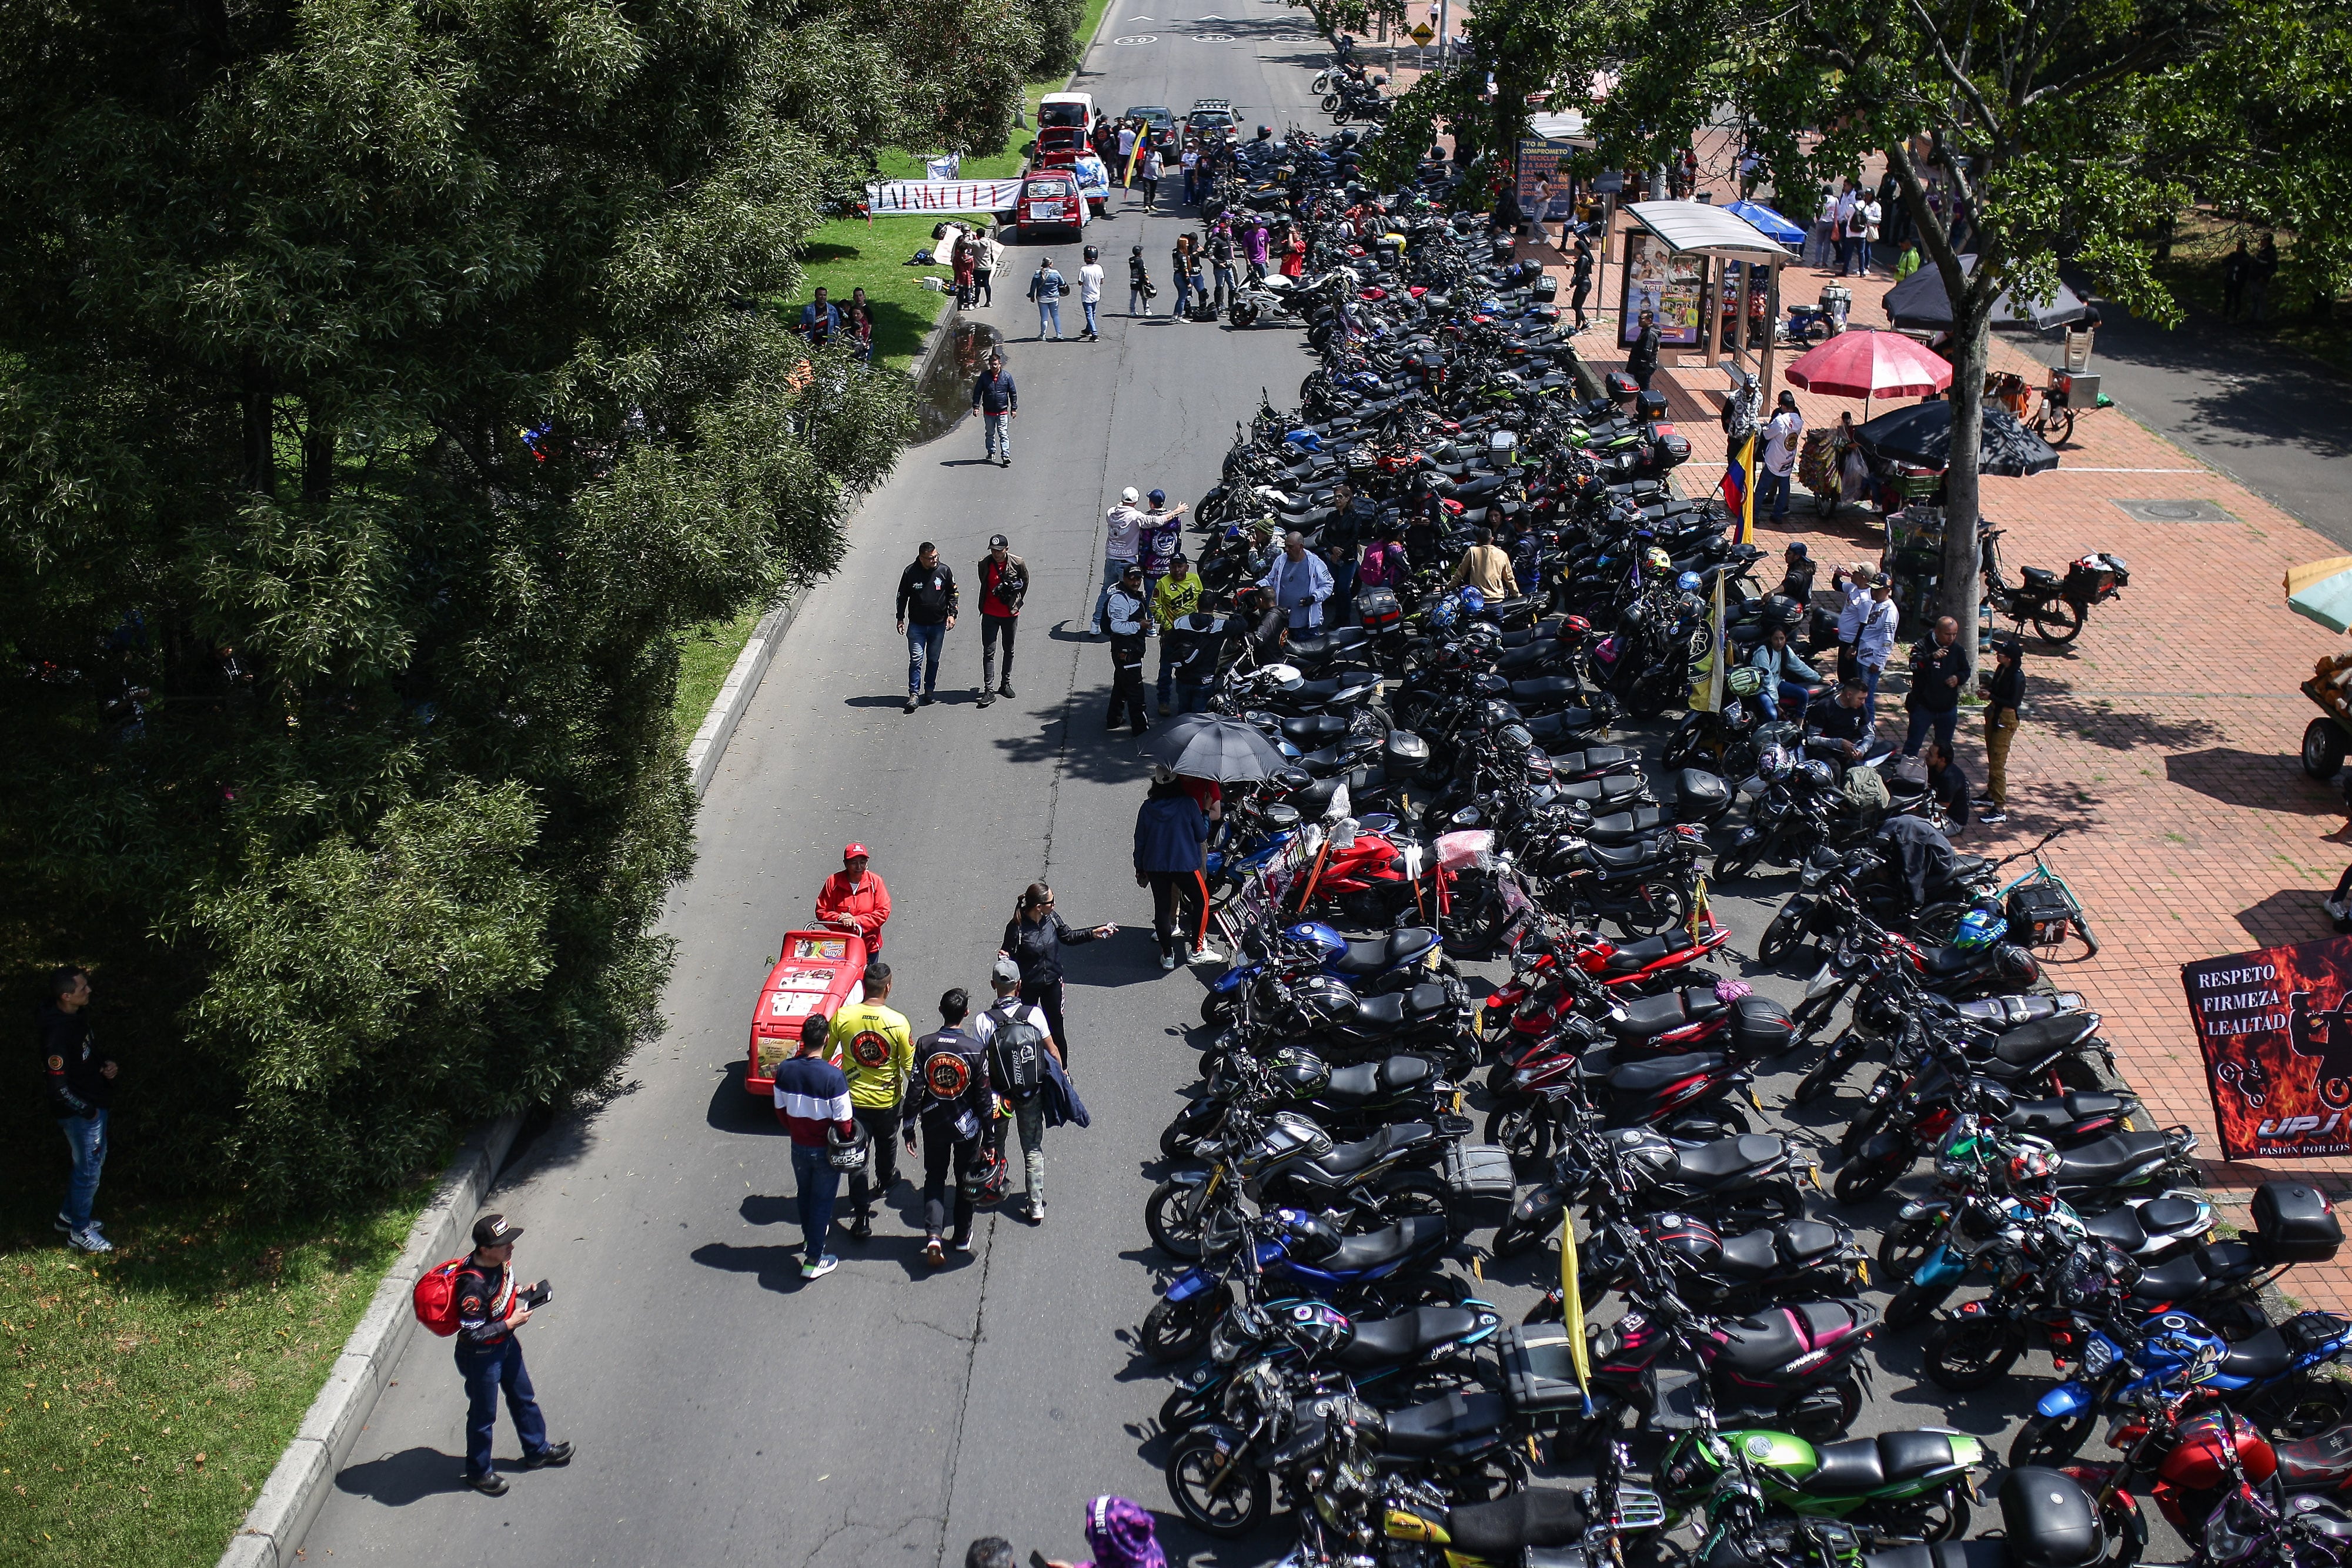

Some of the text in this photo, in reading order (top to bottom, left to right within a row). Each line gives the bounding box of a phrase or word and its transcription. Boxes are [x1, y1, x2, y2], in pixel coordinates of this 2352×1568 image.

[825, 949, 842, 957] hoy?
[2199, 964, 2275, 988] RESPETO
[2203, 989, 2280, 1012] FIRMEZA
[2208, 1013, 2286, 1036] LEALTAD
[933, 1058, 960, 1068] STREET
[1011, 1050, 1023, 1085] MOTEROS
[2257, 1113, 2341, 1139] UPJ
[2260, 1143, 2350, 1155] PASIÓN POR LOS
[1339, 1466, 1359, 1489] BROTHERS
